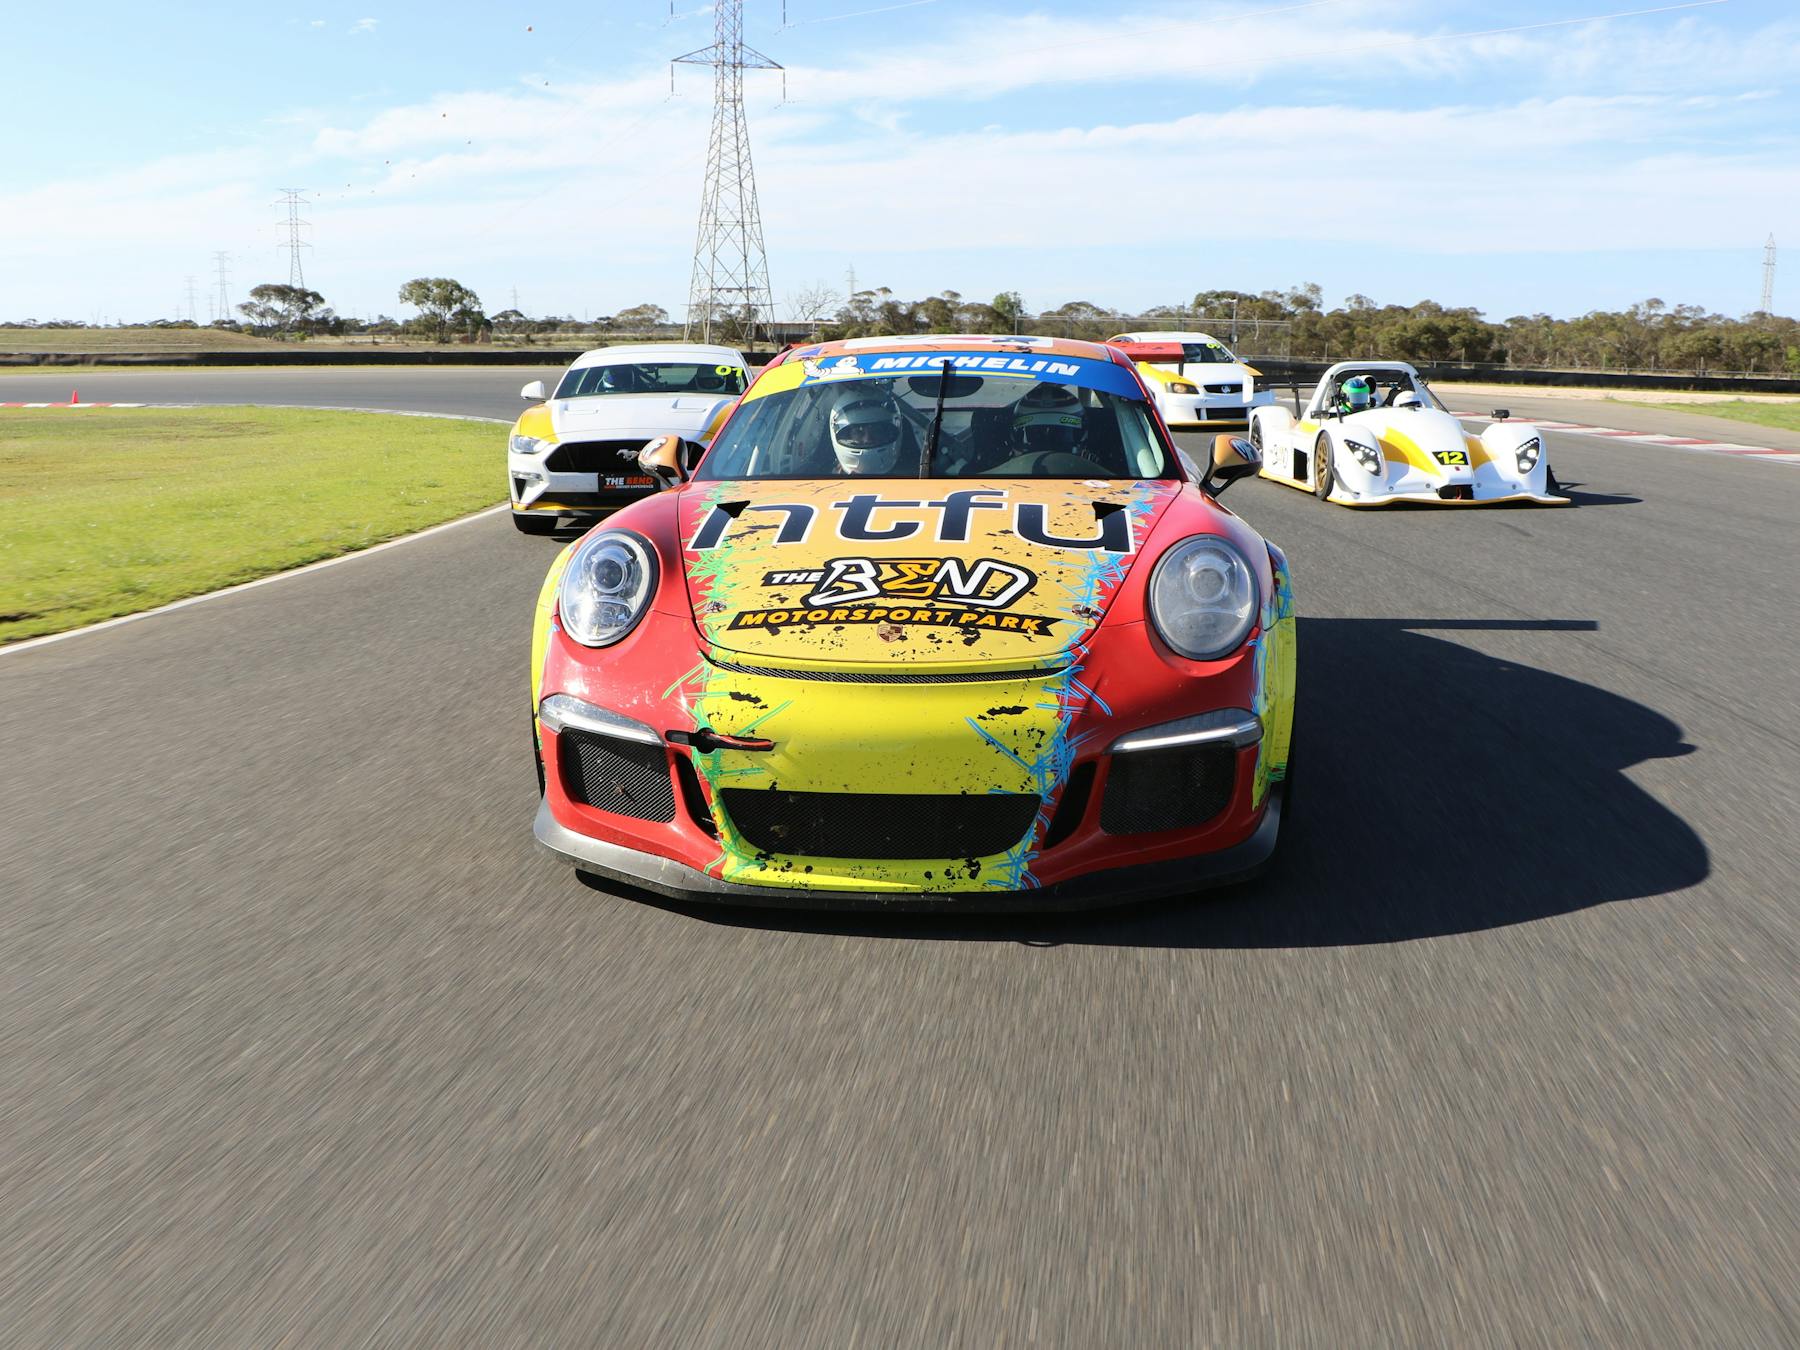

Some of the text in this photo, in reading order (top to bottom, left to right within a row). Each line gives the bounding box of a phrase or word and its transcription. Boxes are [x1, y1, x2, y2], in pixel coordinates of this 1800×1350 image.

[715, 365, 743, 377] 01
[870, 355, 1081, 376] MICHELIN
[1437, 451, 1465, 464] 12
[605, 476, 654, 486] THE BEND
[685, 489, 1136, 555] ntfu
[770, 558, 1030, 606] THE BEND
[738, 608, 1044, 632] MOTORSPORT PARK
